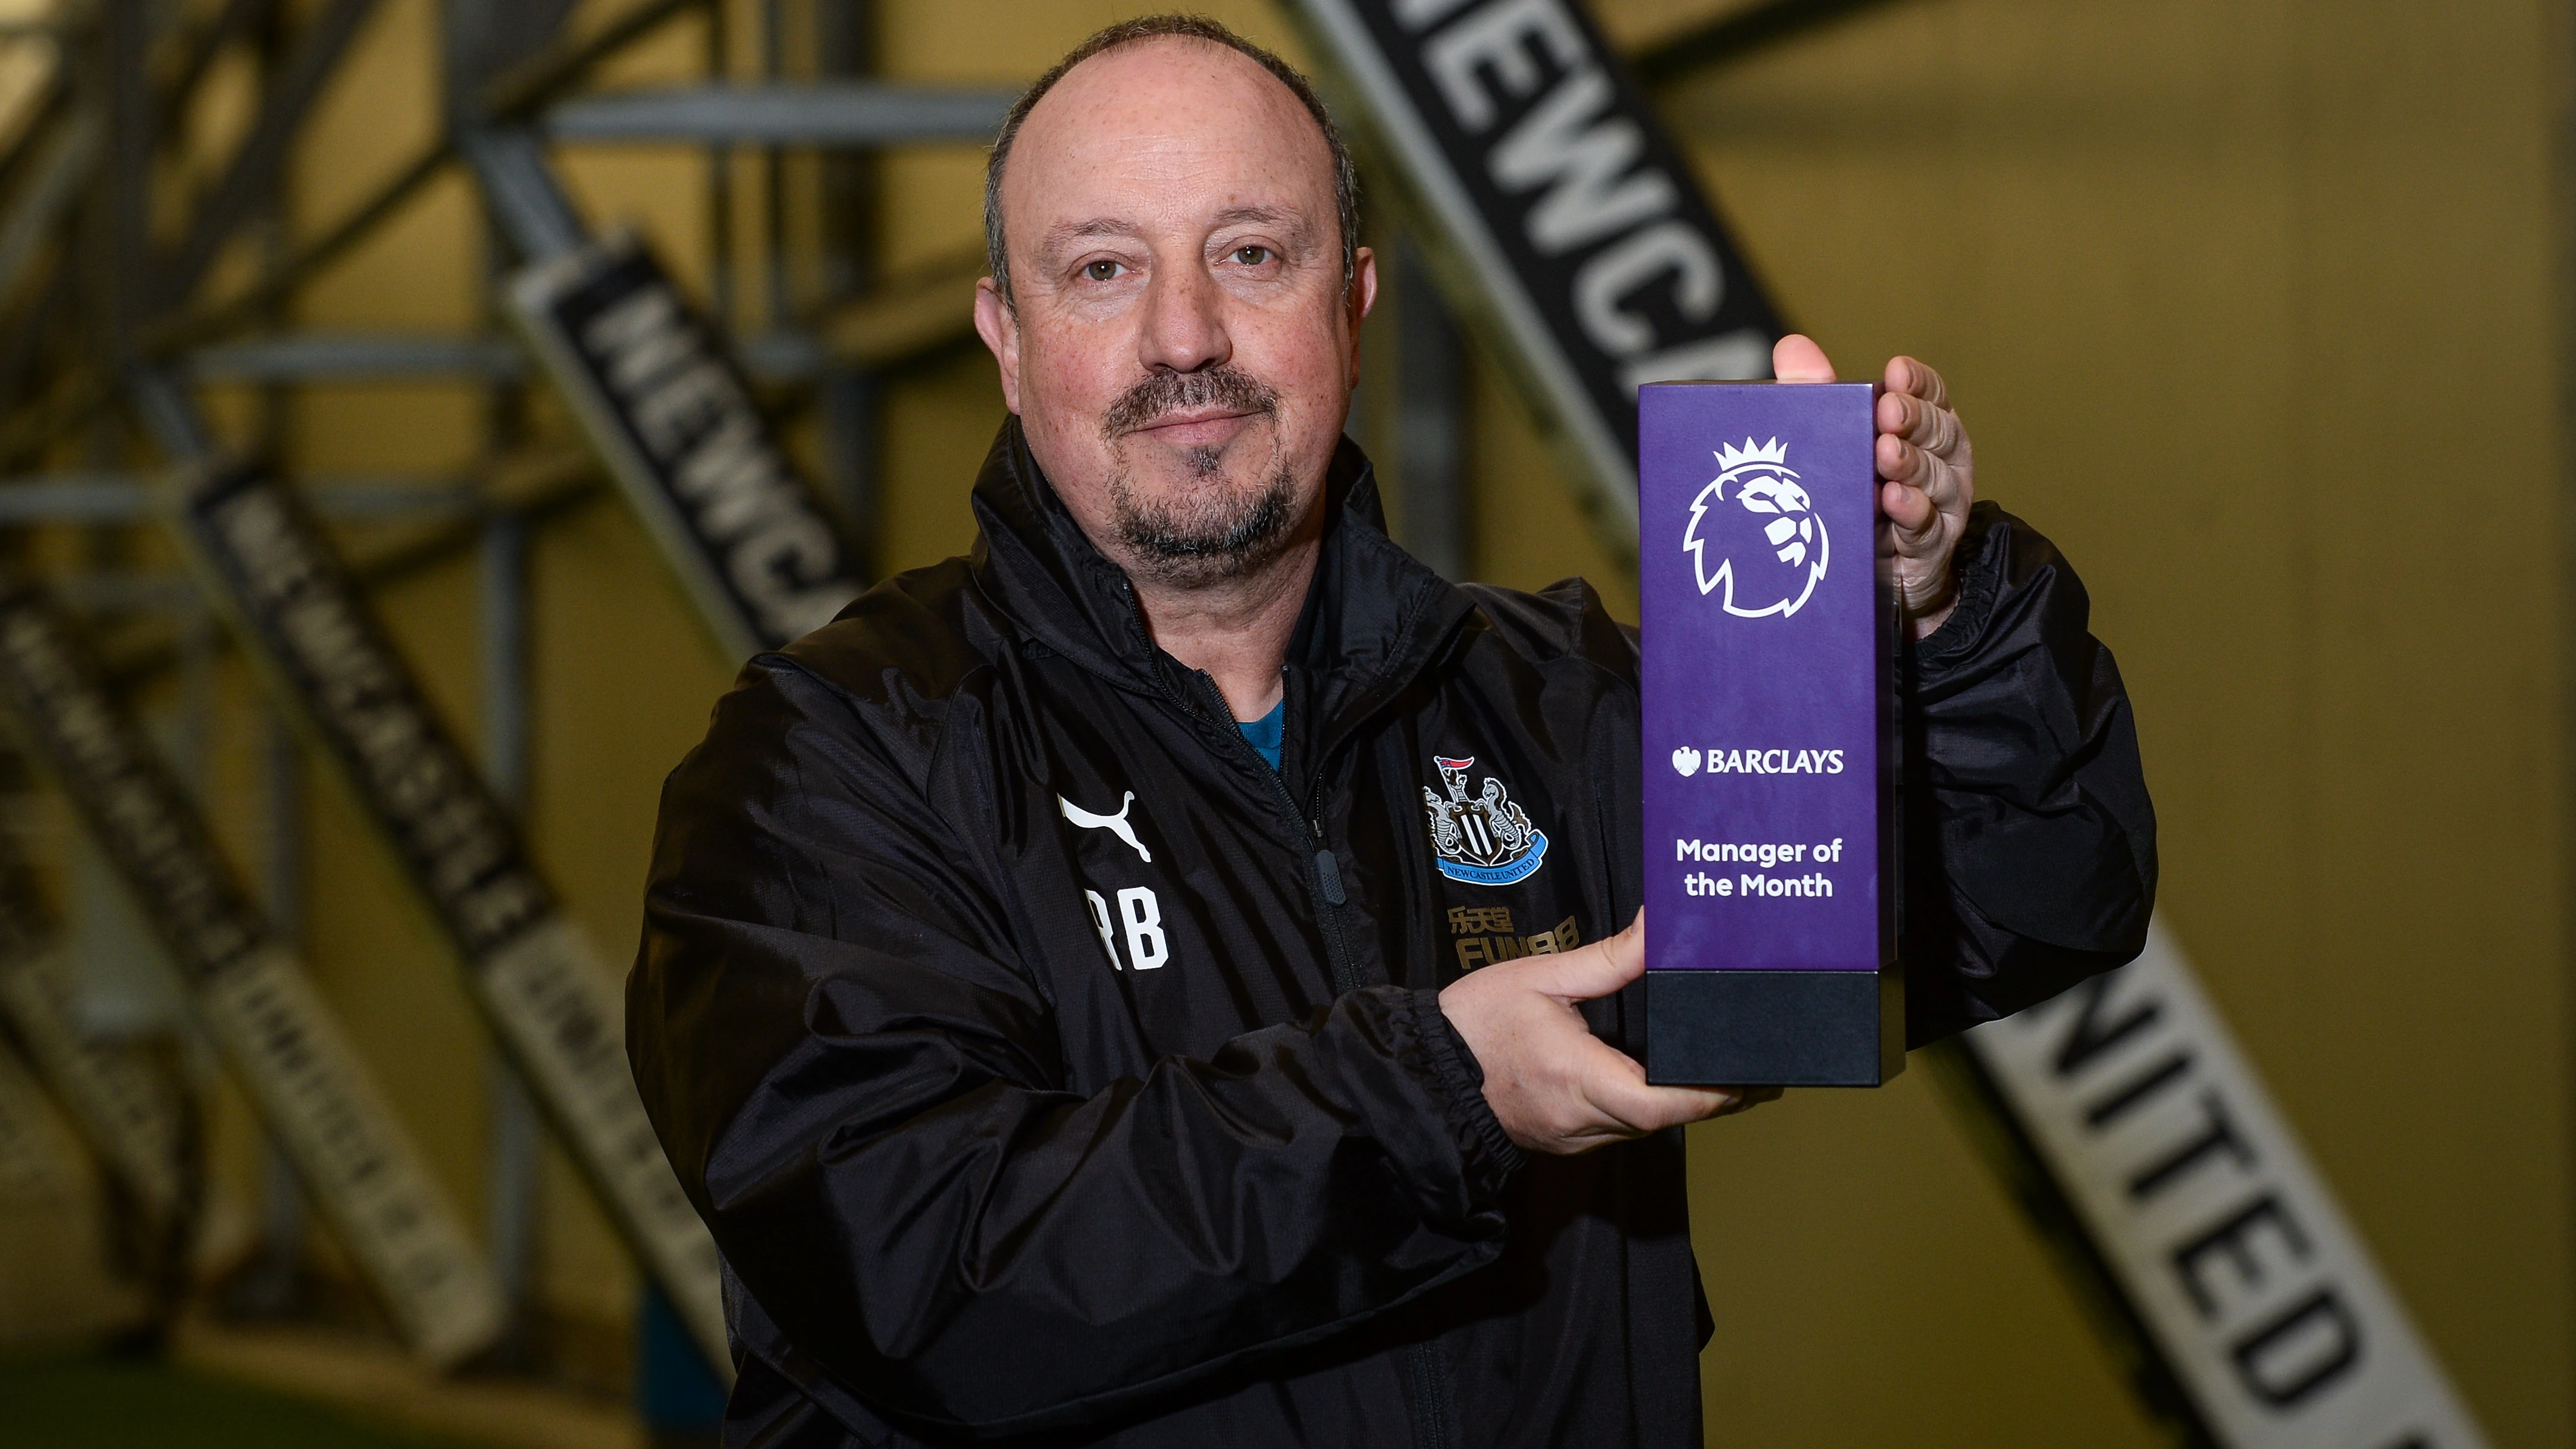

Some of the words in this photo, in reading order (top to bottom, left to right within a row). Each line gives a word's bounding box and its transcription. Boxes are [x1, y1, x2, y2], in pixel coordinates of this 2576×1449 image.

[1387, 0, 1776, 400] EWC
[1707, 749, 1844, 774] BARCLAYS
[1676, 839, 1807, 868] Manager
[1812, 838, 1843, 862] of
[1684, 871, 1733, 896] the
[1741, 873, 1833, 897] Month
[1447, 906, 1515, 934] 乐天堂
[1455, 915, 1580, 970] FUN88
[2020, 970, 2363, 1416] NITED
